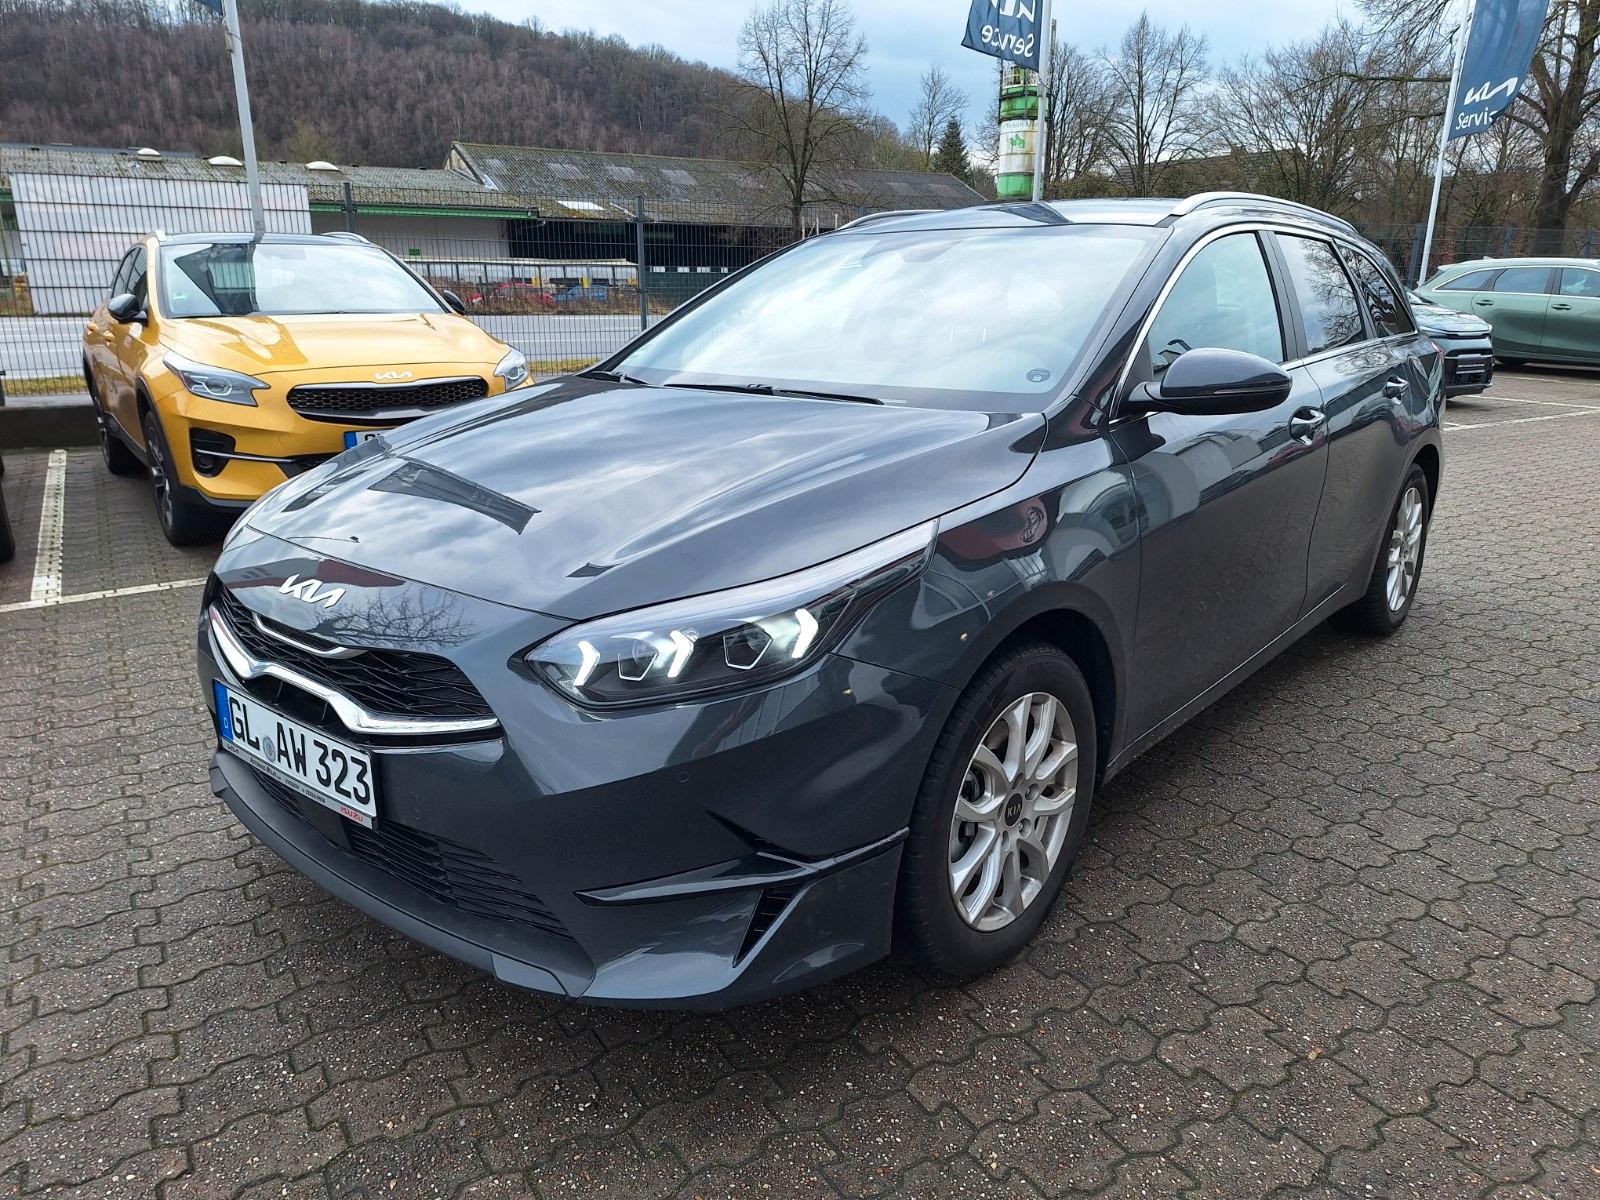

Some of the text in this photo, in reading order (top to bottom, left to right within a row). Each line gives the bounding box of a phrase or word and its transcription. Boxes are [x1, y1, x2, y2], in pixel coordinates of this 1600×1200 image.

[374, 371, 412, 380] KIA
[278, 574, 346, 609] KIA
[229, 696, 260, 751] GL
[276, 721, 307, 777] AW
[313, 739, 371, 806] 323
[340, 806, 364, 822] ISUZU
